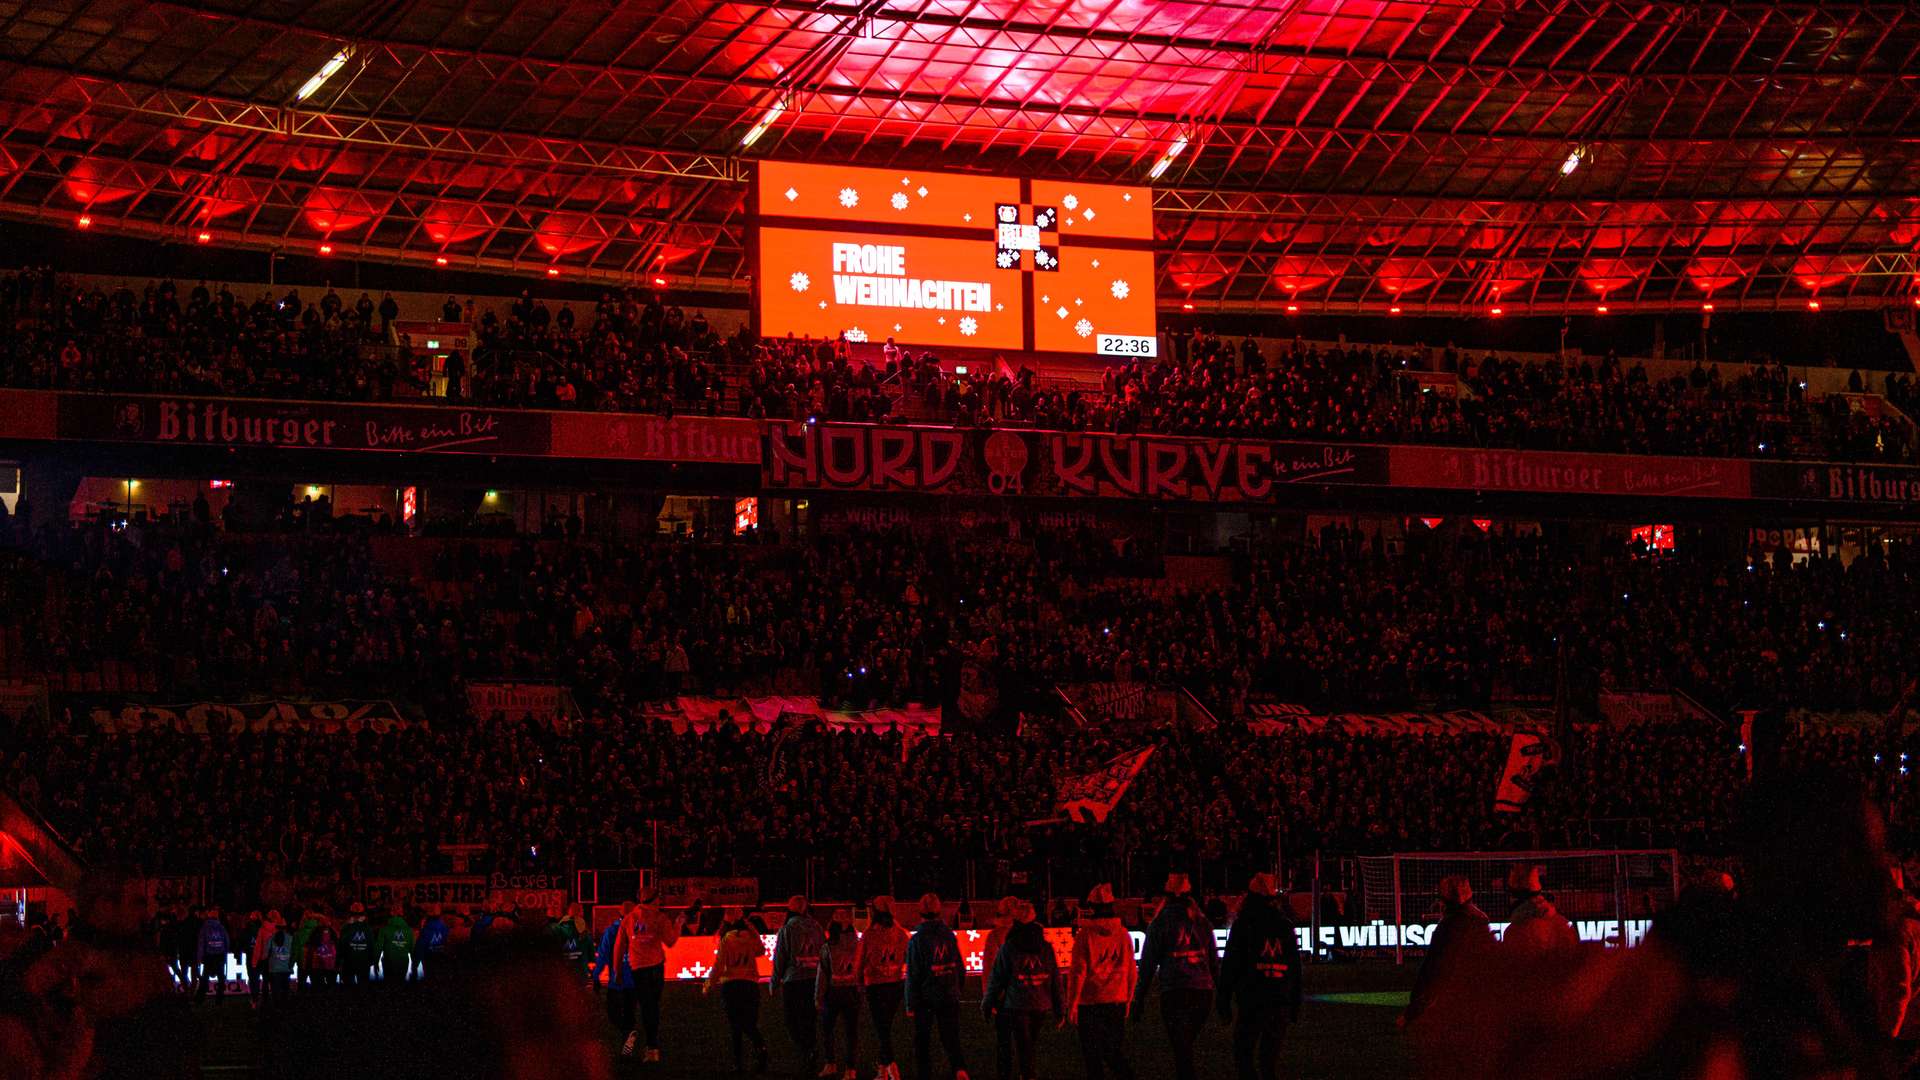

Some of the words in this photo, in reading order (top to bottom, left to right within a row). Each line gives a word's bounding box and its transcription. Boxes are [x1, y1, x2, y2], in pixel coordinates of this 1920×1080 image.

[832, 242, 905, 275] FROHE
[833, 274, 991, 312] WEIHNACHTEN
[1104, 338, 1150, 353] 22:36
[157, 400, 336, 446] Bitburger
[364, 420, 414, 447] Bitte
[420, 425, 453, 439] ein
[459, 412, 497, 437] Bit
[768, 424, 965, 487] NORD
[1050, 437, 1273, 496] KURVE
[1293, 458, 1321, 472] ein
[1323, 447, 1356, 469] Bit
[1472, 454, 1603, 490] Bitburger
